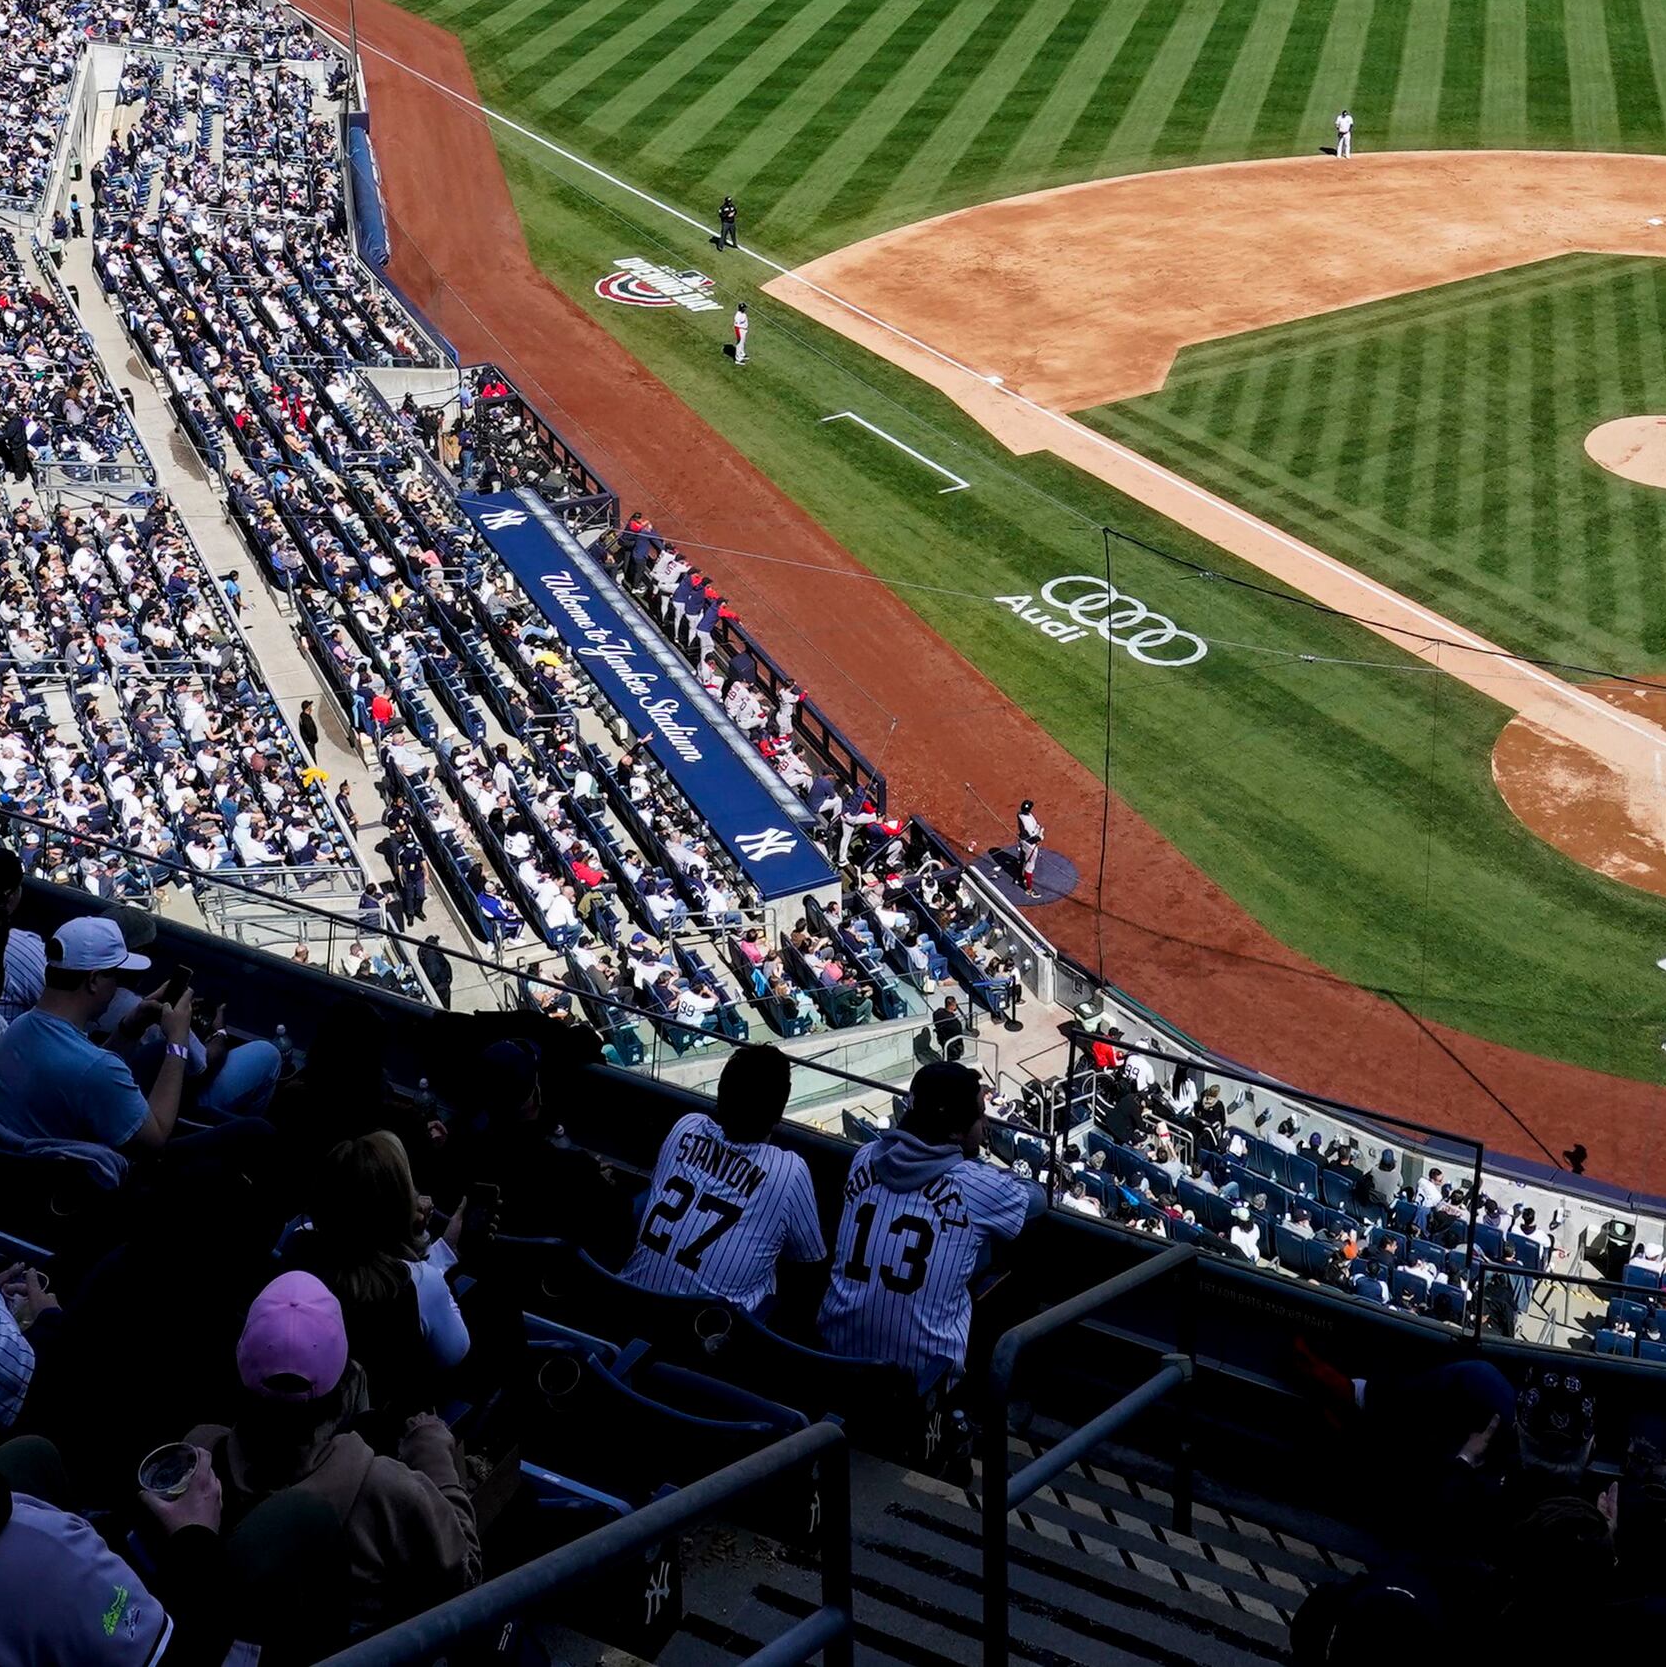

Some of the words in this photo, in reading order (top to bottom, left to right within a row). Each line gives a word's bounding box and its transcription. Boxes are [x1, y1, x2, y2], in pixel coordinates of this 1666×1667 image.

[479, 508, 529, 532] NY
[540, 570, 598, 632] Welcome
[994, 595, 1090, 644] Audi
[587, 627, 607, 645] to
[578, 638, 661, 698] Yankee
[637, 692, 704, 764] Stadium
[734, 827, 799, 863] NY
[676, 1132, 767, 1199] STANTON
[640, 1174, 746, 1274] 27
[844, 1201, 936, 1297] 13
